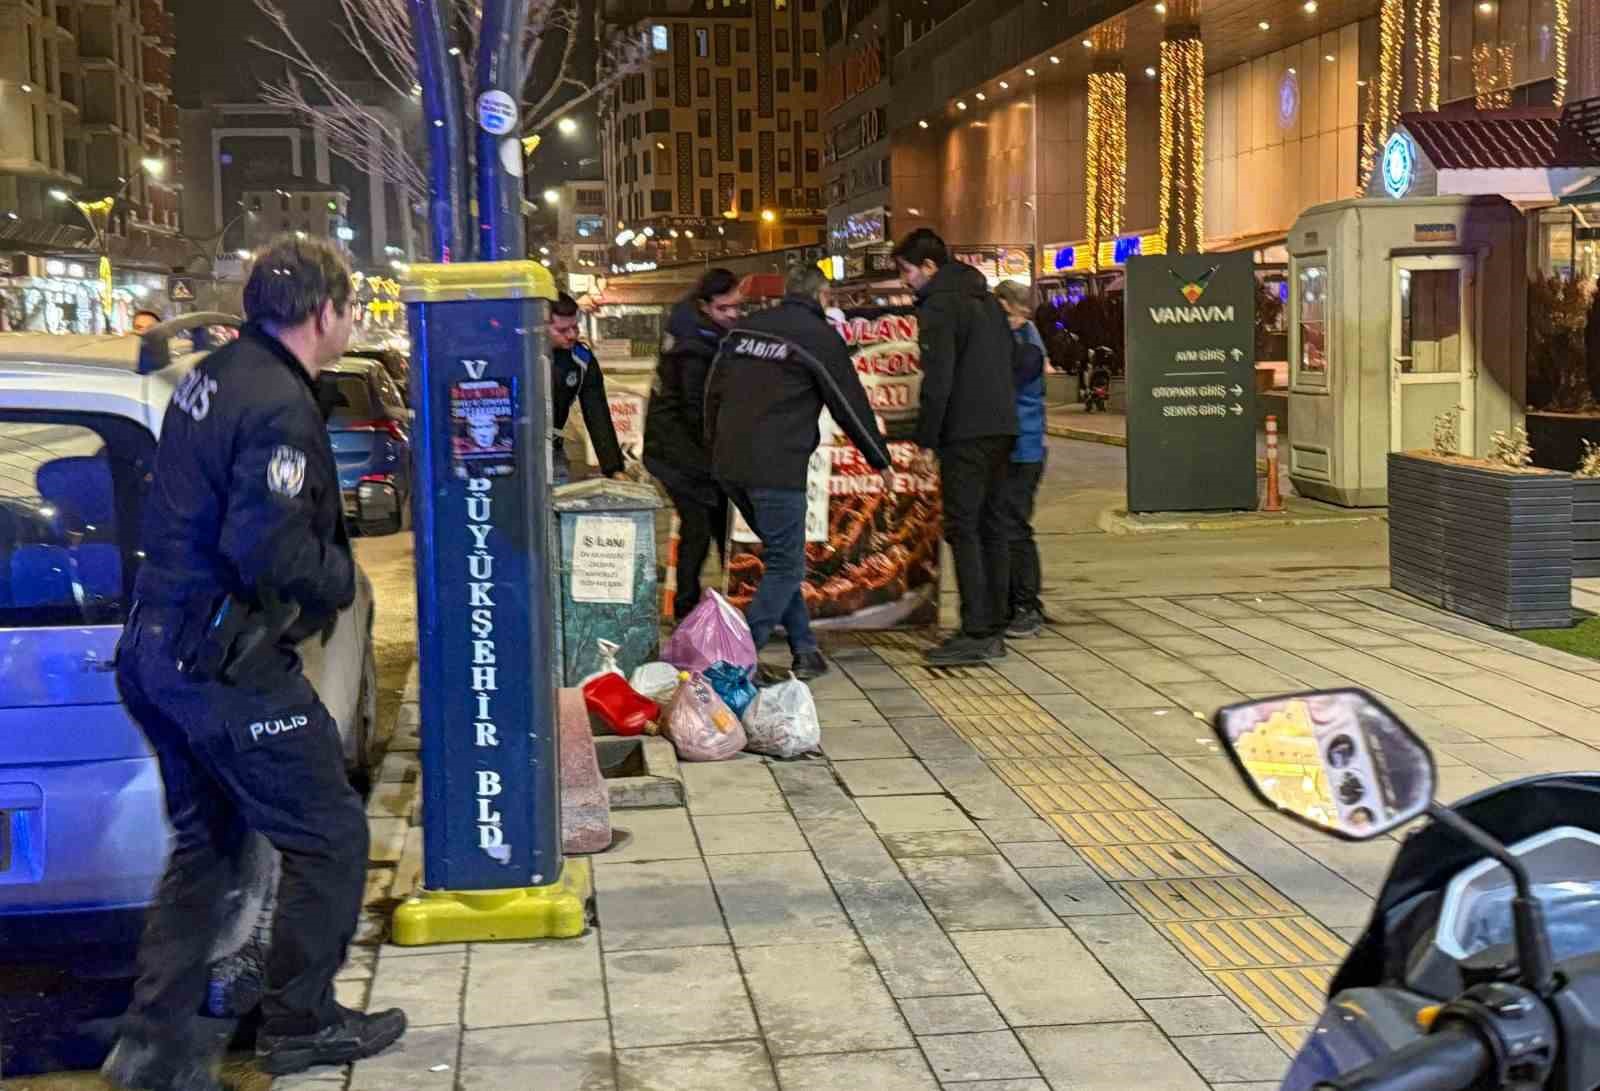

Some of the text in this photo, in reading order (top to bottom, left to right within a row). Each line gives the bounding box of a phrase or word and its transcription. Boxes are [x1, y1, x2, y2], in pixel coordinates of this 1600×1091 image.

[1149, 306, 1234, 324] VANAVM
[1175, 350, 1198, 361] AVM
[1151, 386, 1197, 399] OTOPARK
[465, 478, 499, 747] BÜYÜKŞEHİR
[474, 770, 504, 849] BLD
